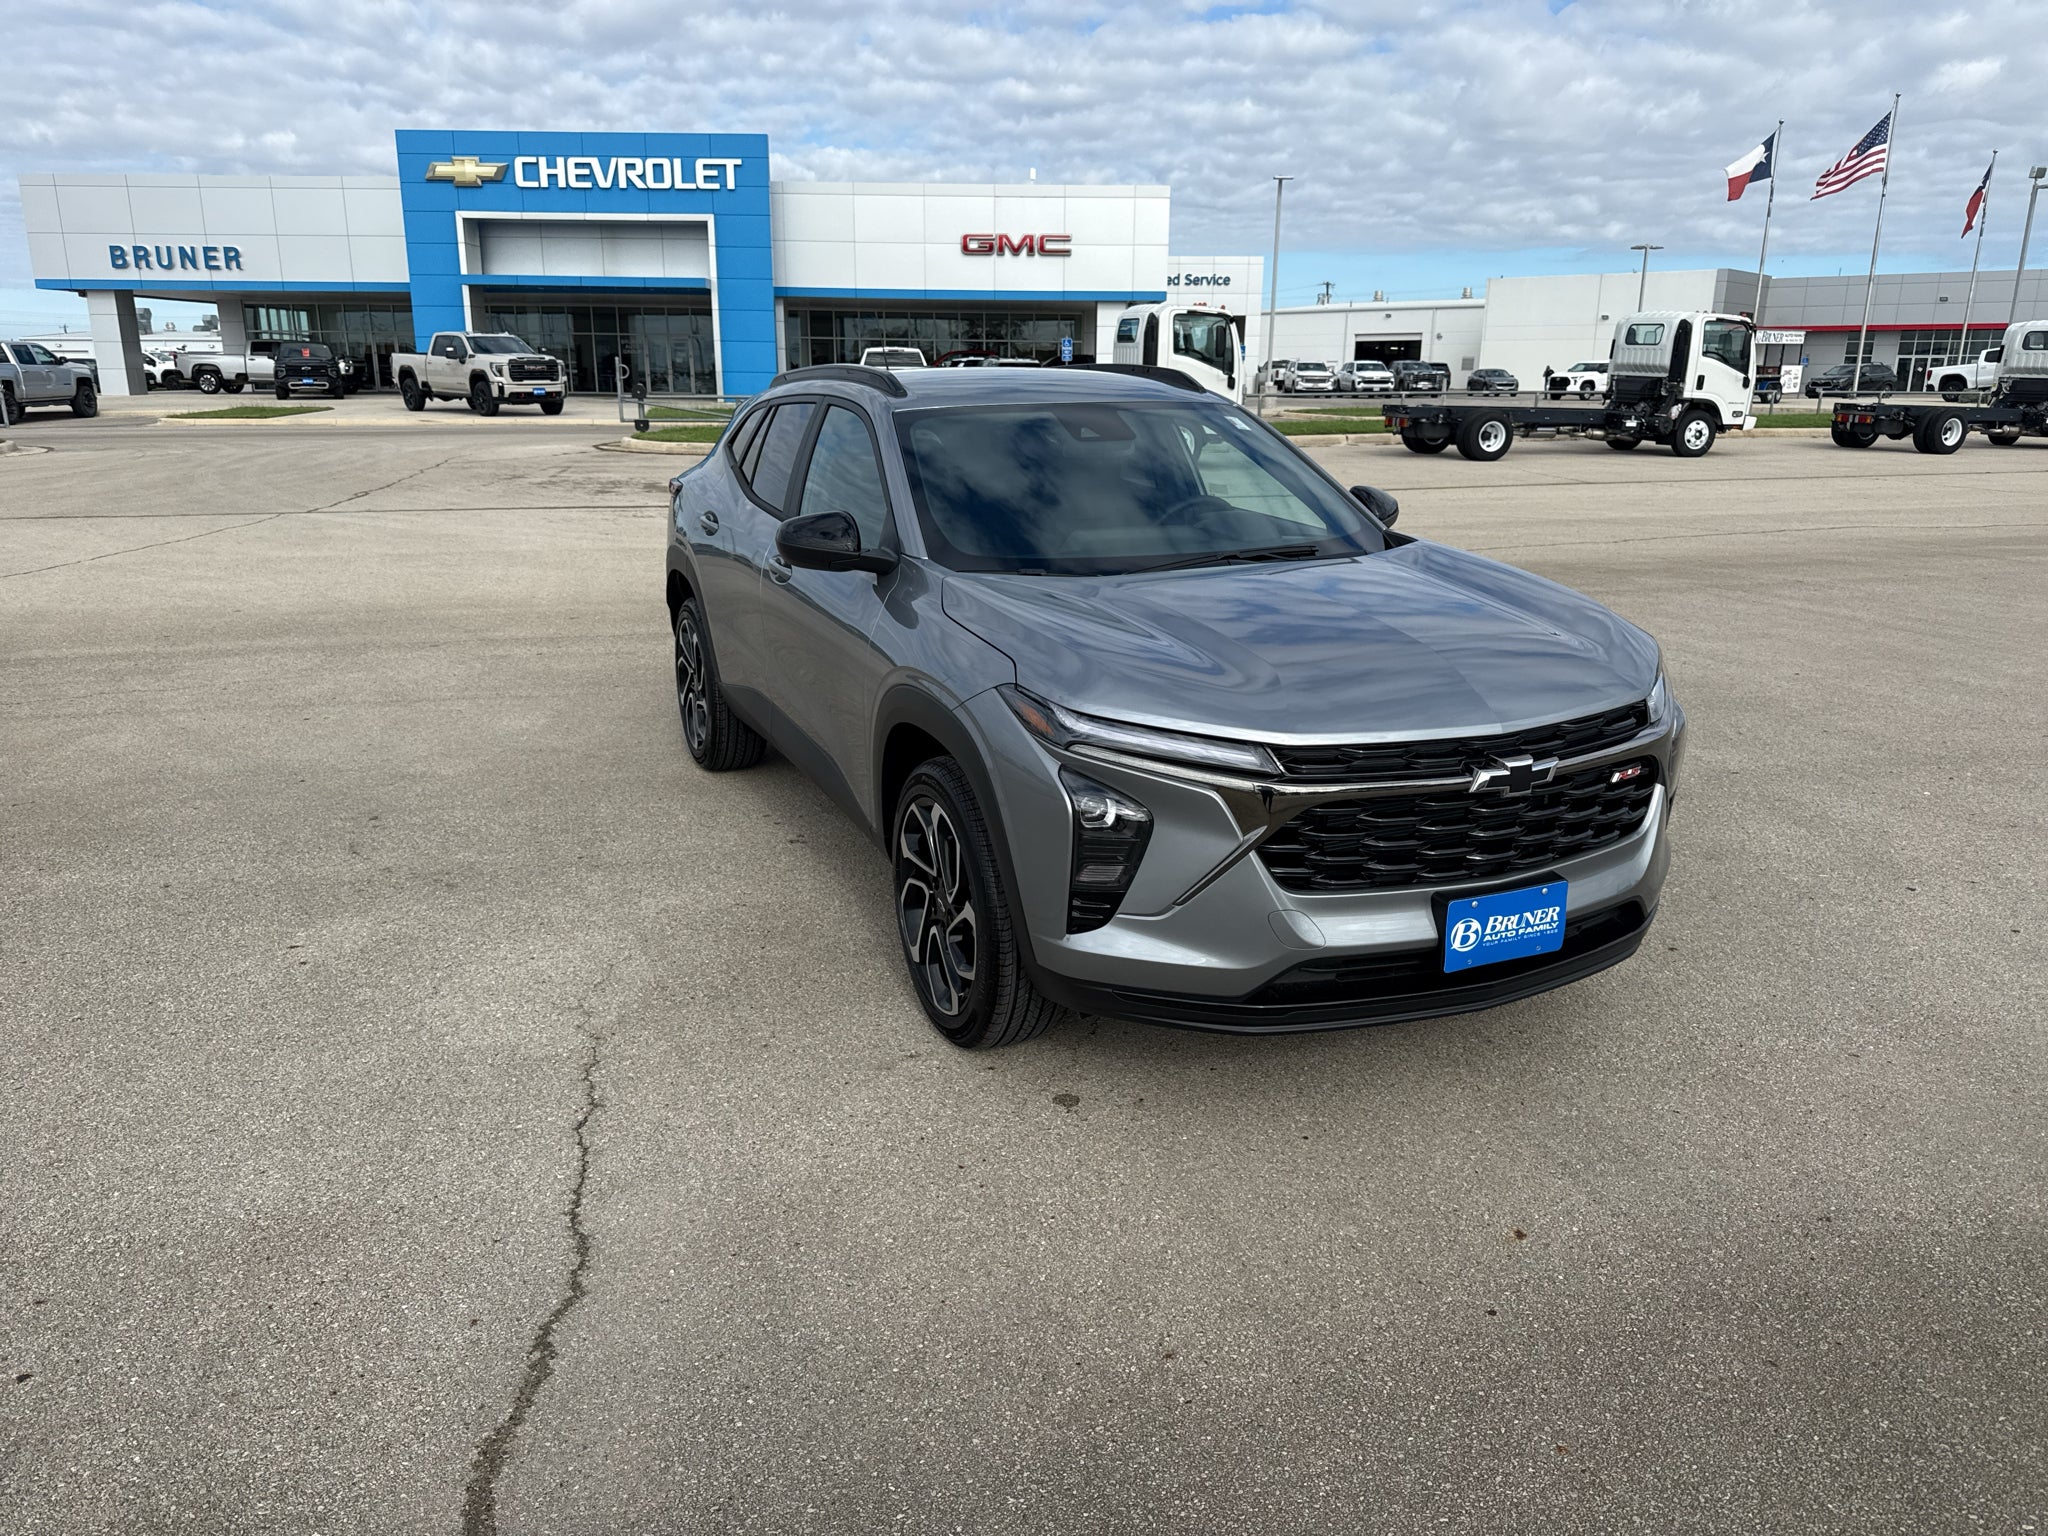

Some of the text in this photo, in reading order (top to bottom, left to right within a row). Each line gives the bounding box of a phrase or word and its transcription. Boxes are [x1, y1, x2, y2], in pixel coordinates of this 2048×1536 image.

[514, 156, 742, 190] CHEVROLET
[961, 233, 1072, 256] GMC
[109, 245, 243, 270] BRUNER
[1184, 273, 1231, 286] Service
[1483, 921, 1560, 942] AUTO FAMILY
[1484, 906, 1560, 935] BRUNER
